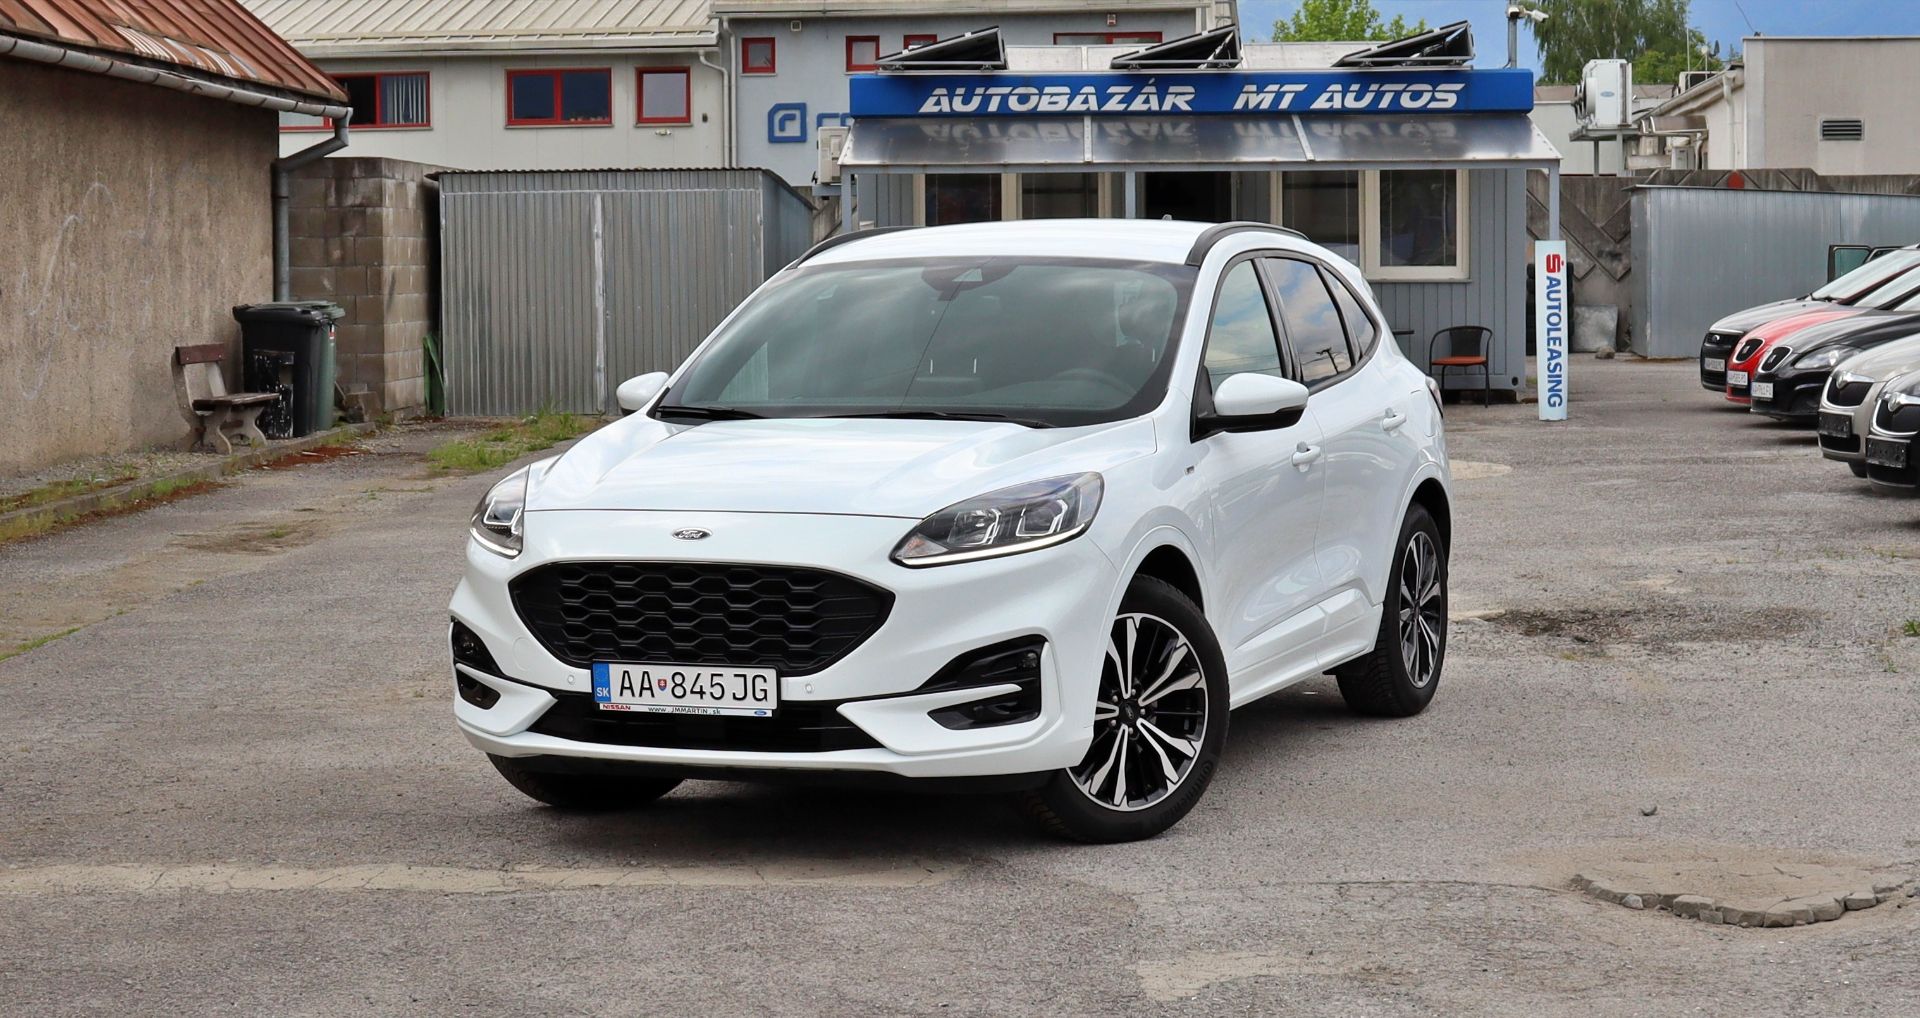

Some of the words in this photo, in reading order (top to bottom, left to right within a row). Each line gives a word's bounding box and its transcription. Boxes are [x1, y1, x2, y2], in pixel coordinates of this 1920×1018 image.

[918, 78, 1196, 112] AUTOBAZÁR
[1233, 84, 1308, 110] MT
[1310, 83, 1465, 109] AUTOS
[1546, 275, 1563, 408] AUTOLEASING
[596, 687, 610, 697] SK
